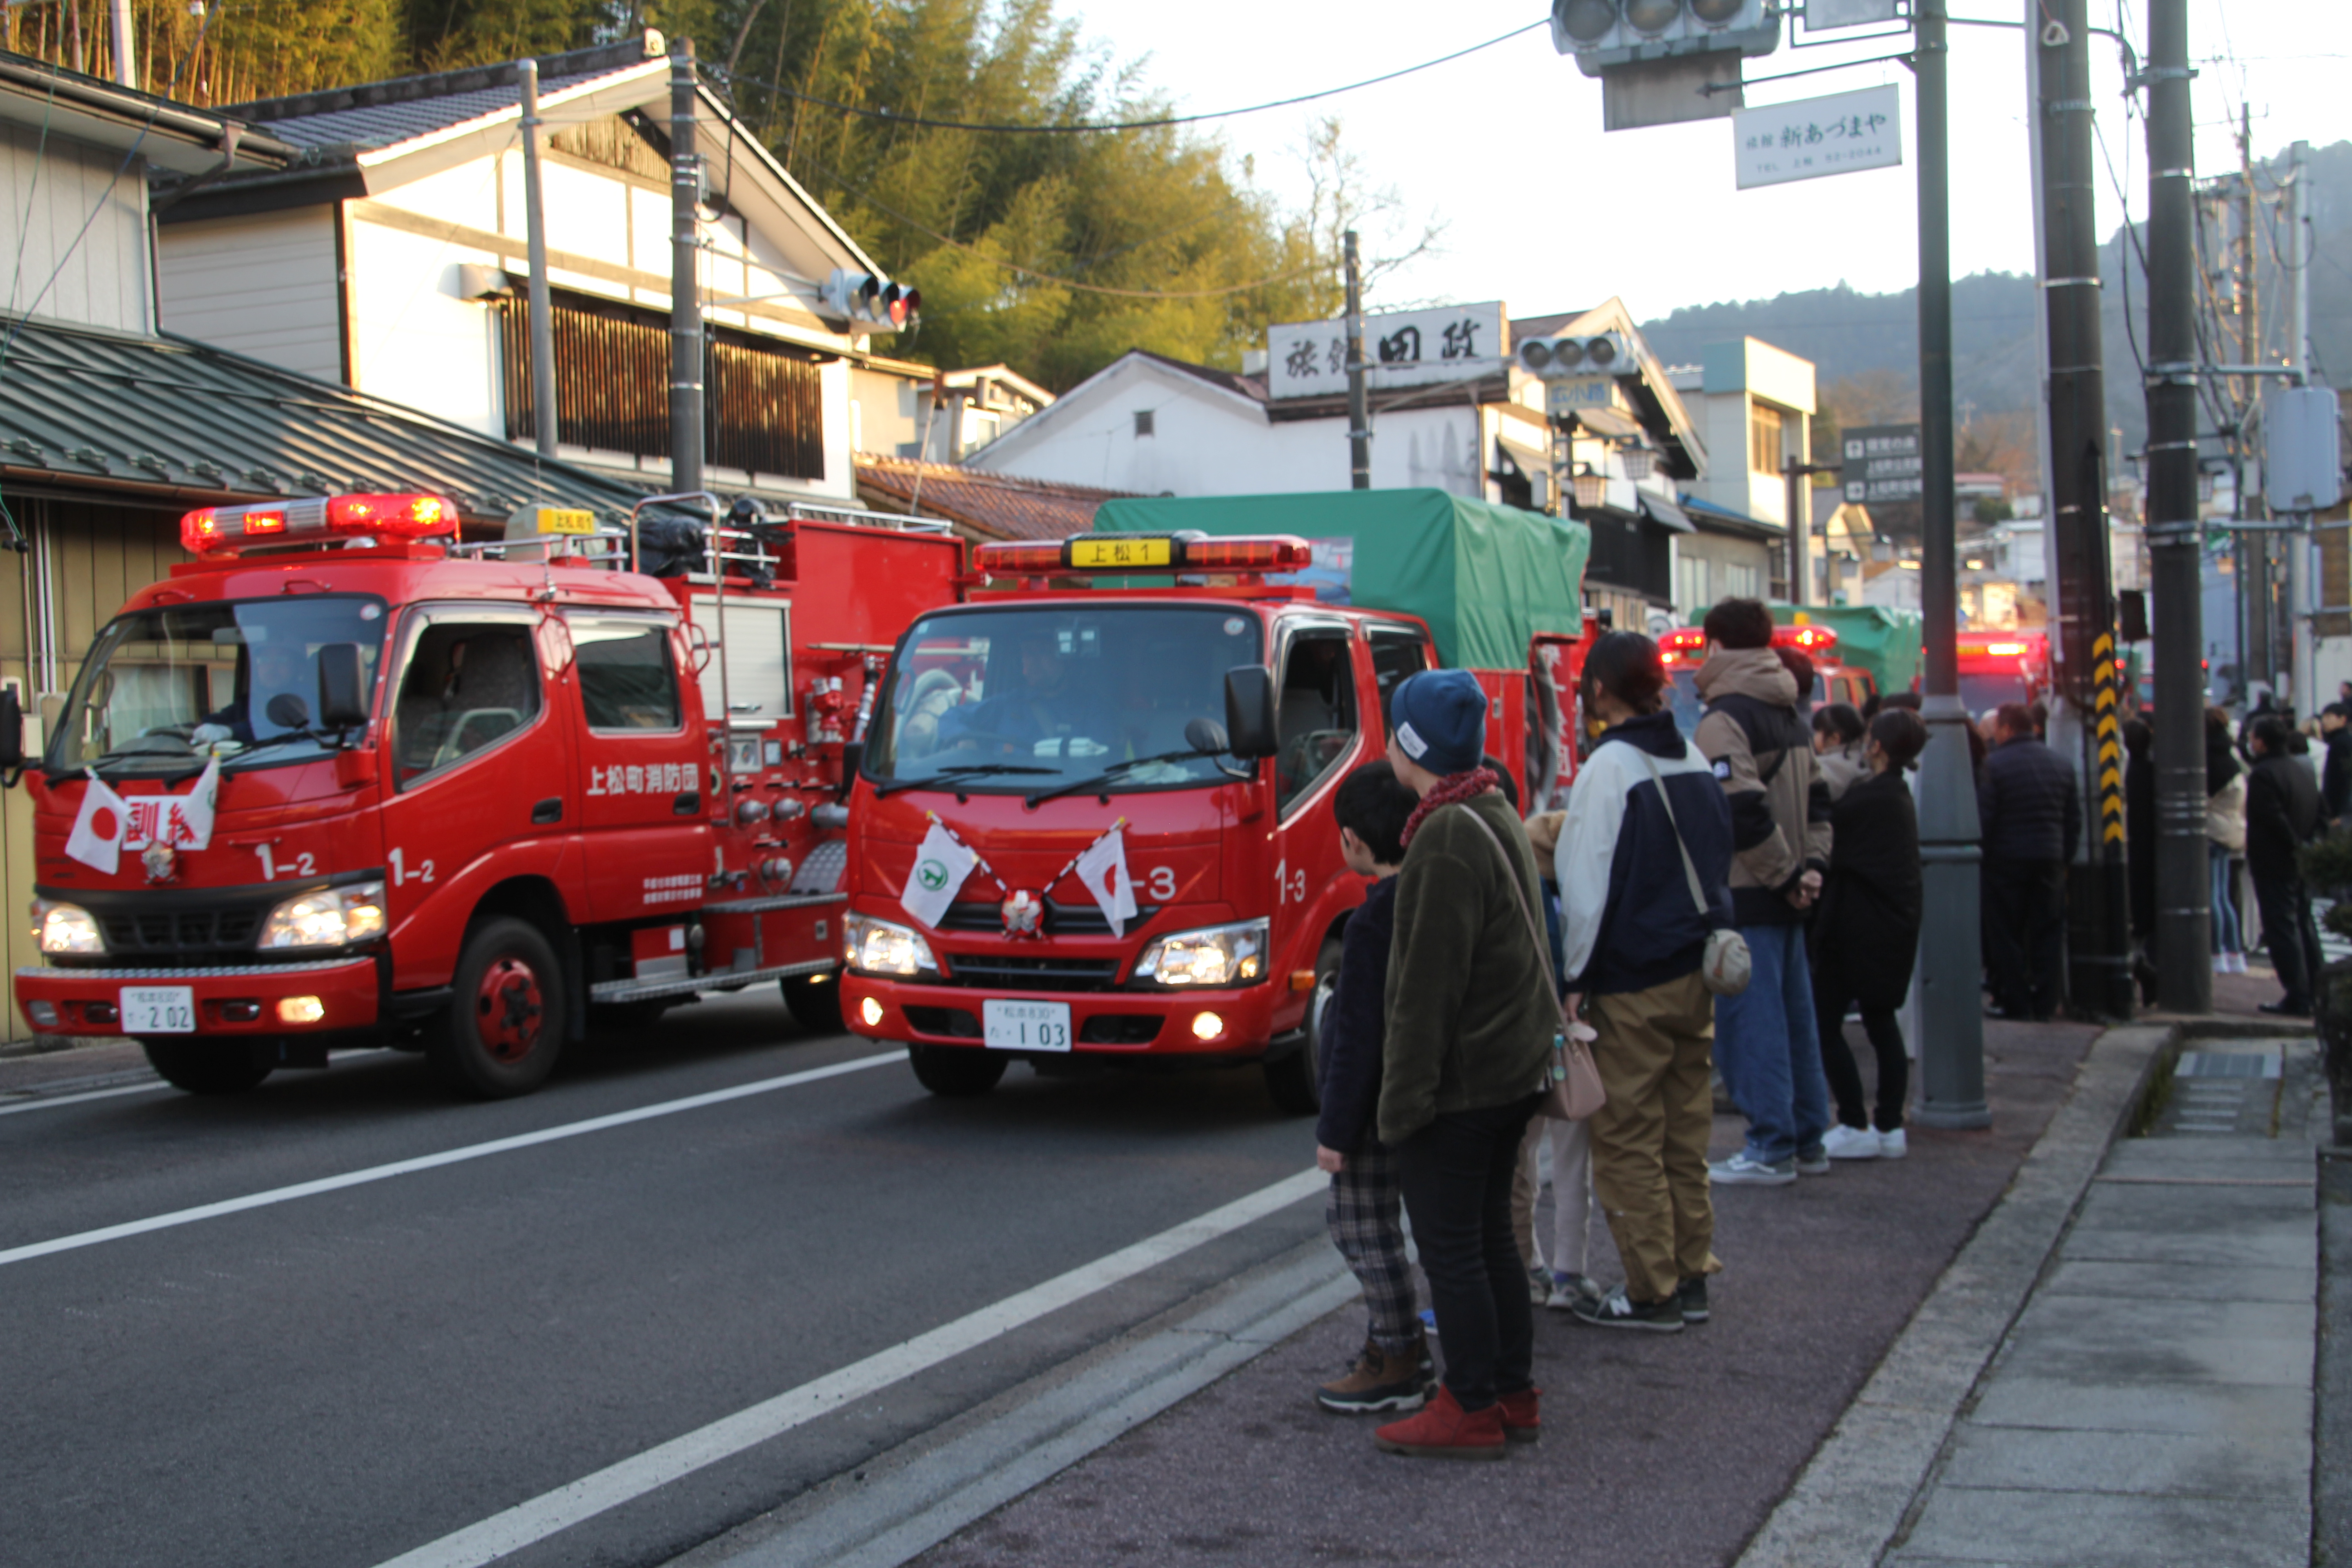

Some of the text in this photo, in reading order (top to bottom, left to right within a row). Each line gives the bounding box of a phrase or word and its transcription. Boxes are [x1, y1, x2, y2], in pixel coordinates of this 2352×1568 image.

[1780, 113, 1886, 149] 新あづまや
[1757, 163, 1779, 173] TEL
[1090, 544, 1148, 564] 上松1
[587, 763, 699, 795] 上松町消防団
[255, 843, 317, 881] 1-2
[388, 847, 436, 887] 1-2
[1275, 858, 1306, 905] 1-3
